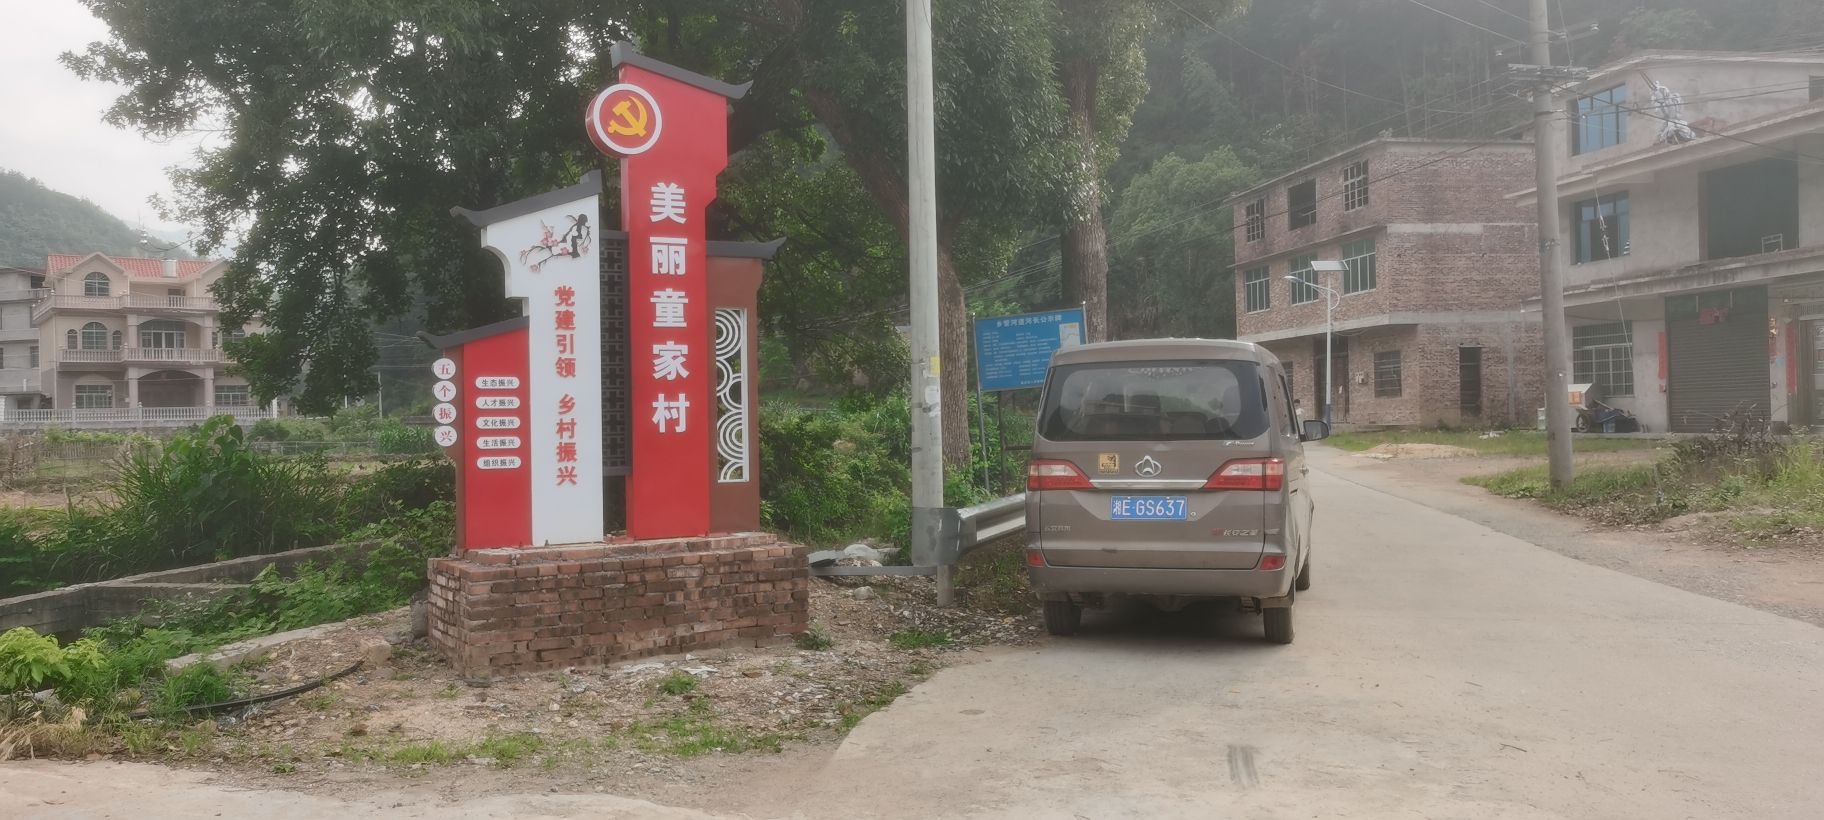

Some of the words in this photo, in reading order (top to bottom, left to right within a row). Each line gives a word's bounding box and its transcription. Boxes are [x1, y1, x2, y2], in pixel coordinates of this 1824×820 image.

[649, 182, 690, 433] 美丽童家村
[554, 285, 576, 378] 党建引领
[481, 378, 514, 388] 生态振兴
[439, 363, 453, 443] 五个振兴
[482, 398, 515, 408] 人才振兴
[482, 418, 515, 428] 文化振兴
[483, 438, 516, 448] 生活振兴
[556, 393, 578, 486] 乡村振兴
[483, 458, 516, 468] 组织振兴
